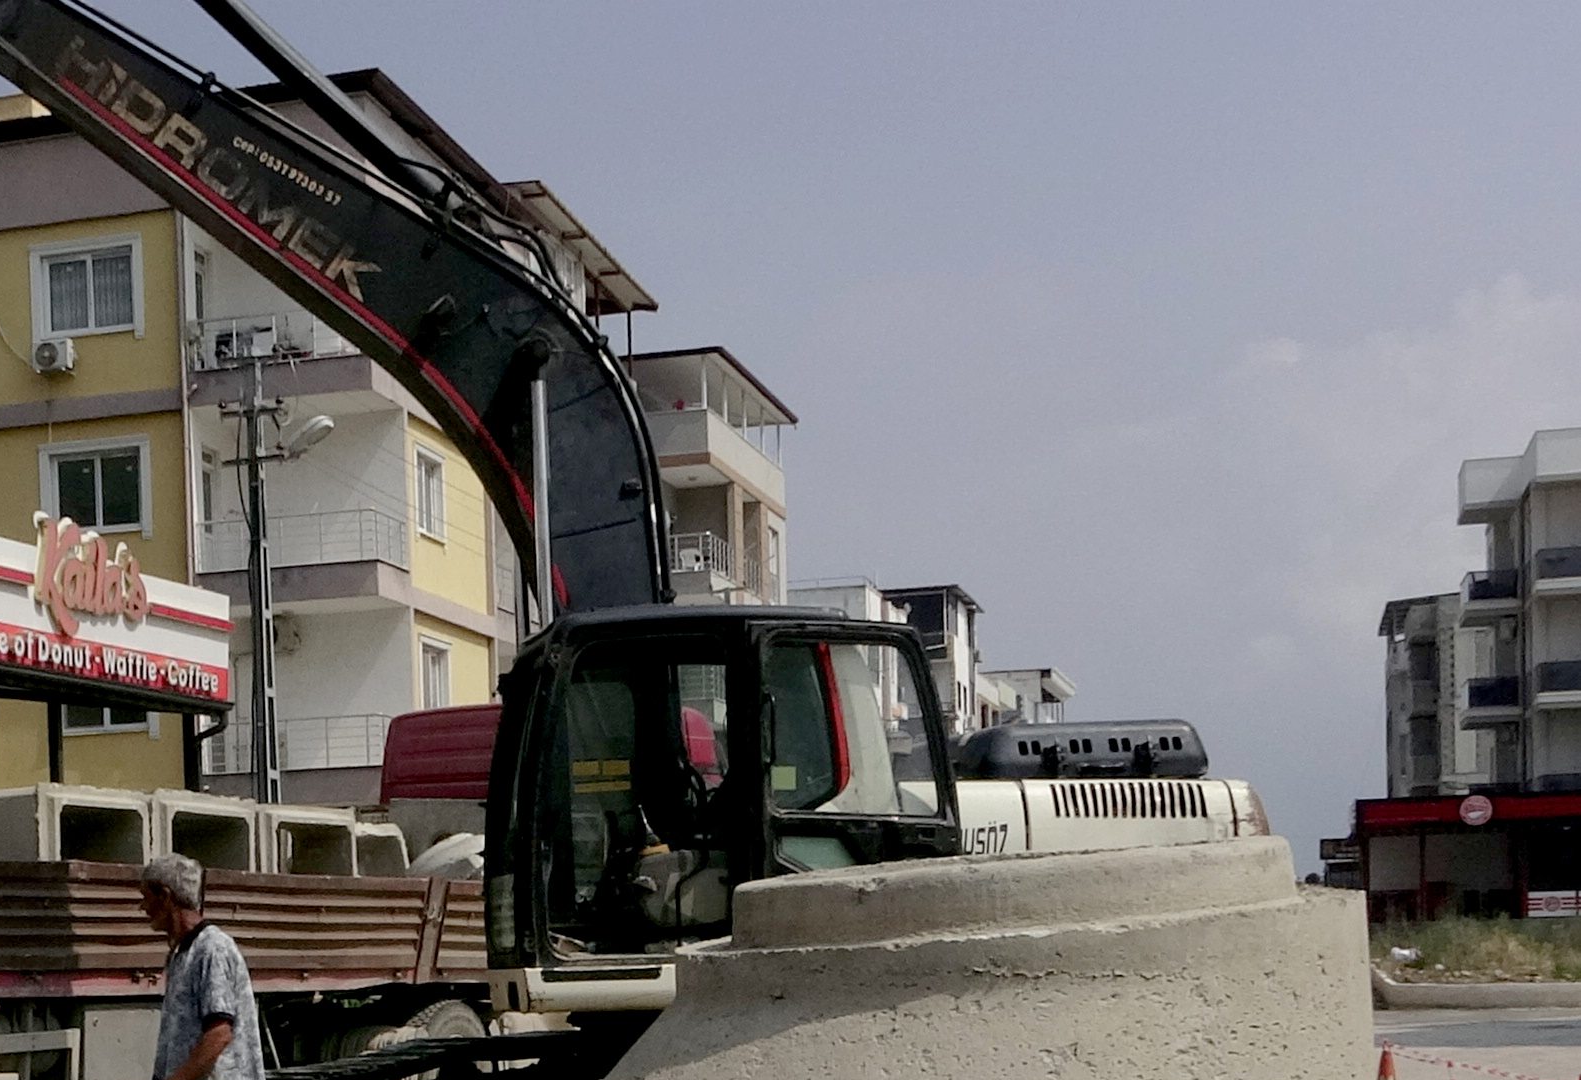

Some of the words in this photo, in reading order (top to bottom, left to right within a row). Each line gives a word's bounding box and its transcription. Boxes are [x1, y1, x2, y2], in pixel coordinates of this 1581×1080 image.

[14, 629, 35, 657] of
[38, 634, 91, 670] Donut
[103, 650, 158, 683] Waffle
[168, 661, 219, 694] Coffee
